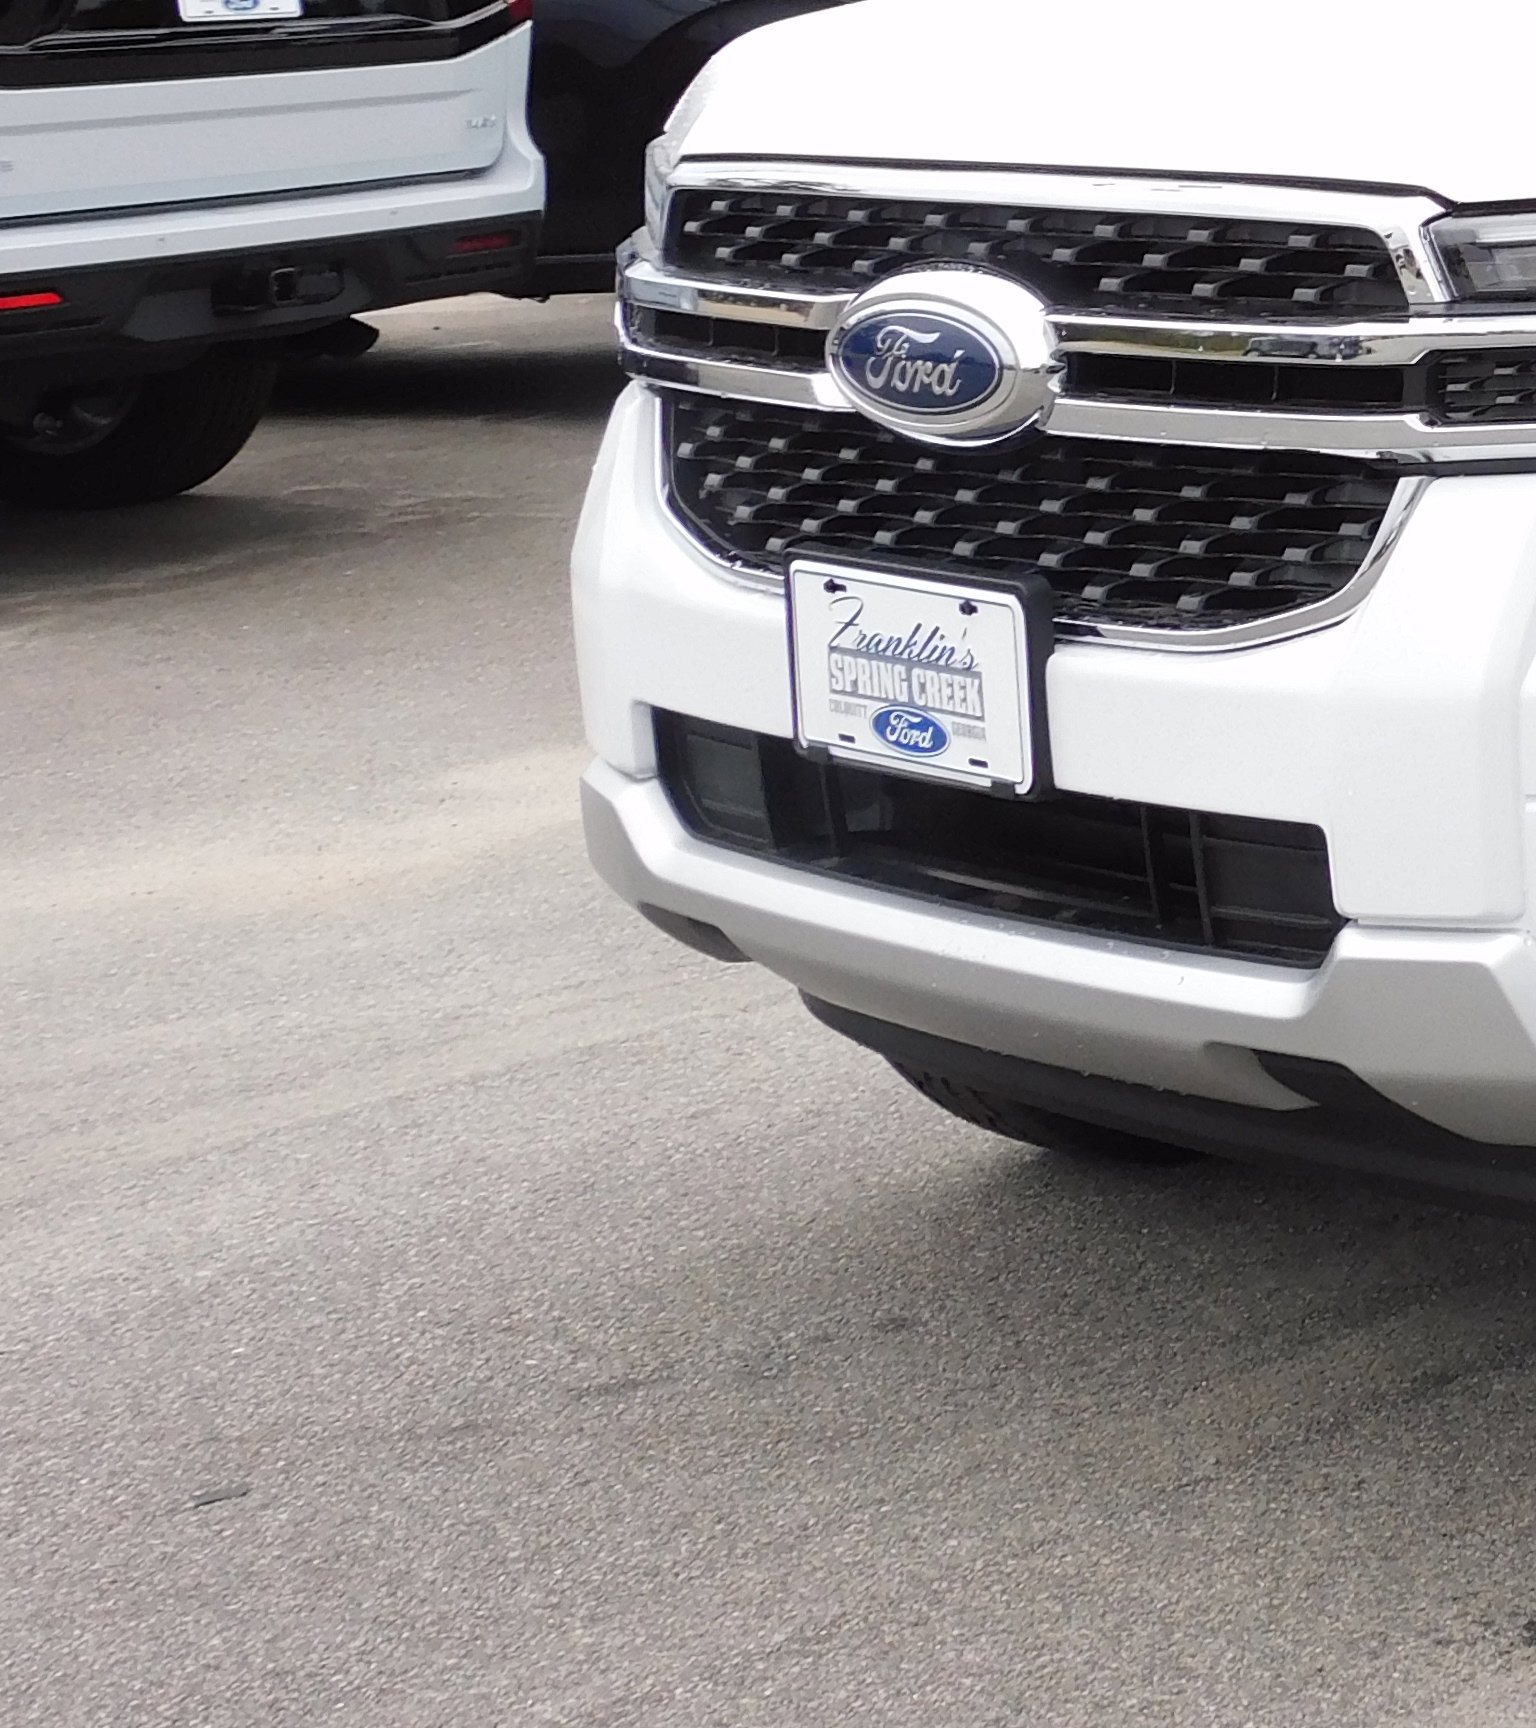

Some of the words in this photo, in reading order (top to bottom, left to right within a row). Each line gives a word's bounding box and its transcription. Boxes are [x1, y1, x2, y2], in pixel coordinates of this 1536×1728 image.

[865, 325, 966, 396] Ford
[828, 596, 979, 670] Franklin's
[830, 652, 909, 703] SPRING
[911, 668, 983, 717] CREEK
[885, 711, 934, 749] Ford
